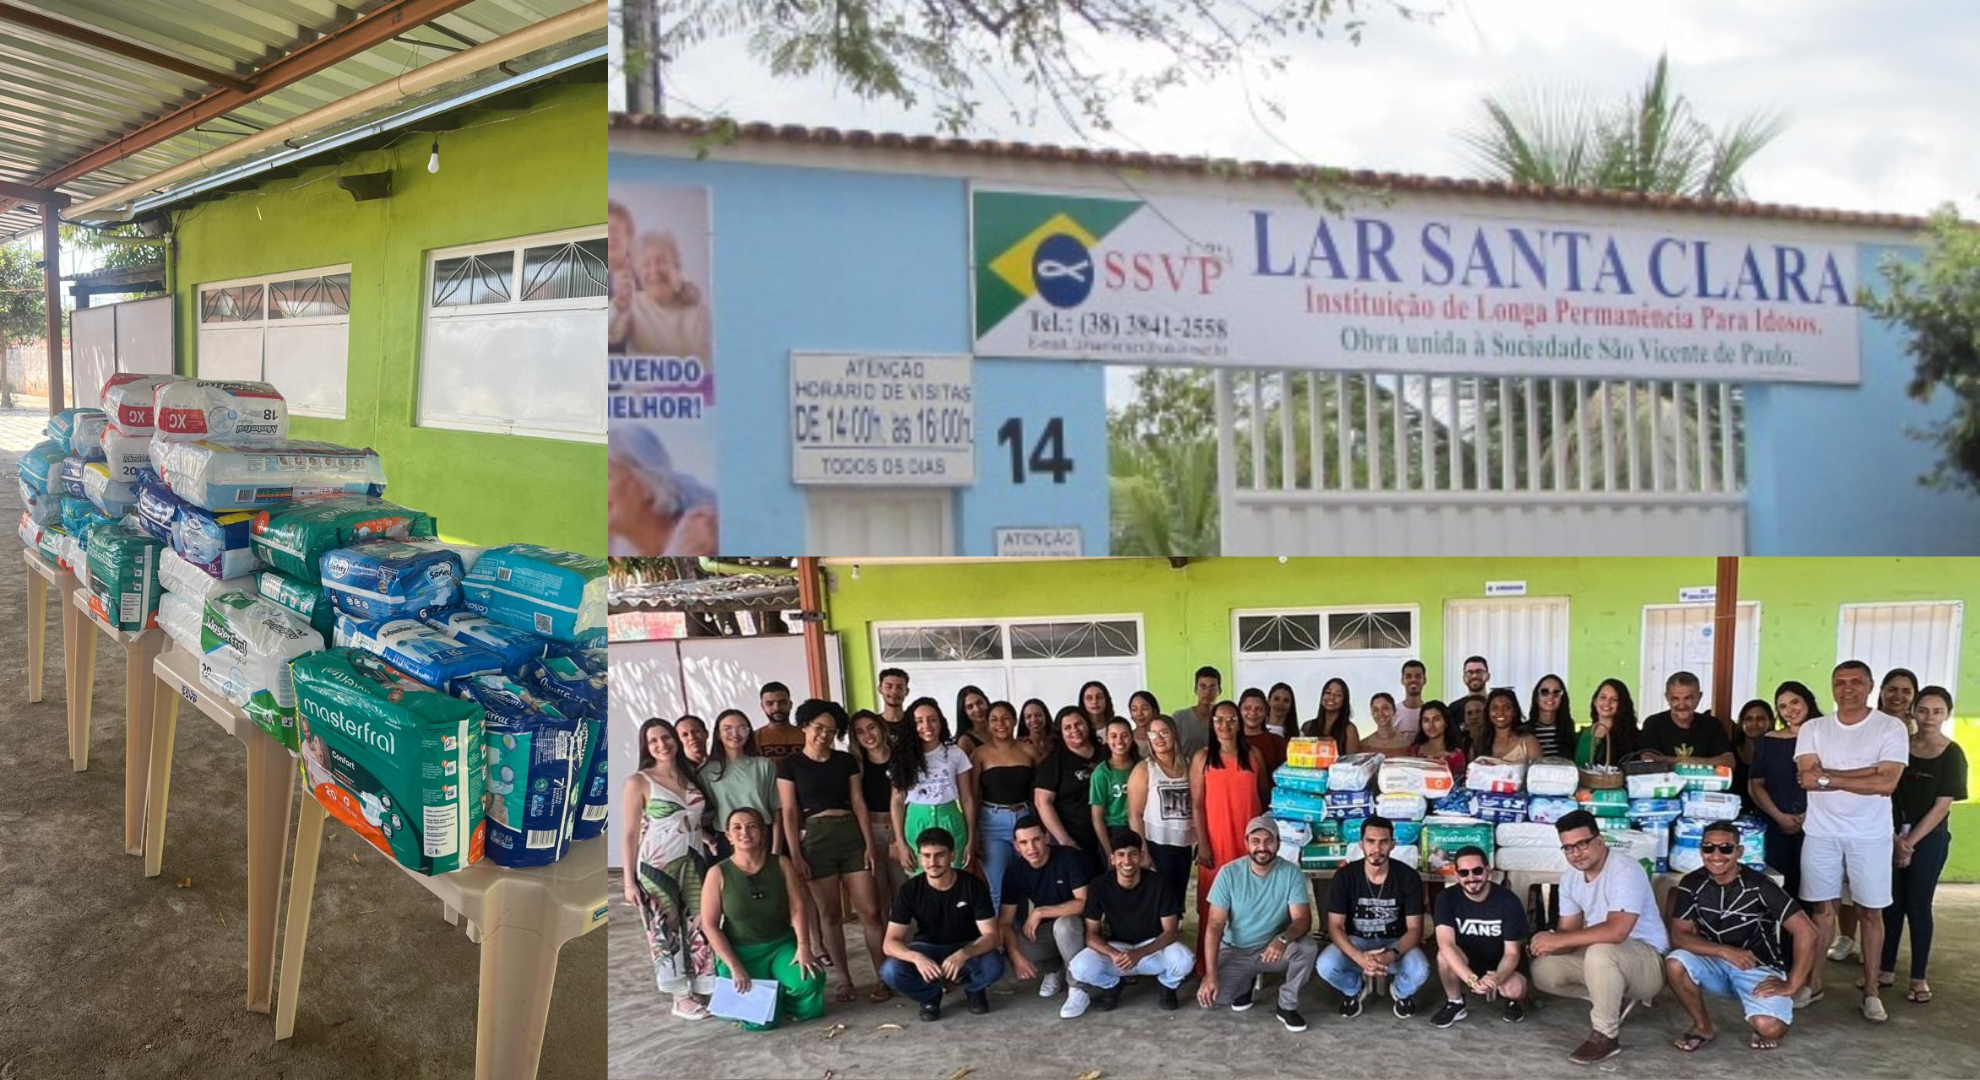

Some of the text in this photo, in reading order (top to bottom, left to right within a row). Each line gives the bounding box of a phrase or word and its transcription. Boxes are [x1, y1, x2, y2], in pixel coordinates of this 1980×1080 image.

[1249, 209, 1857, 306] LAR SANTA CLARA
[1104, 250, 1223, 295] SSVP
[1305, 285, 1823, 335] Instituição de Longa Permanência Para Idosos.
[1028, 309, 1229, 339] Tel.: (38) 3841-2558
[1340, 326, 1399, 353] Obra
[1406, 330, 1467, 357] unida
[1492, 332, 1593, 361] Sociedade
[1599, 336, 1634, 361] São
[1638, 338, 1708, 364] Vicente
[1713, 342, 1737, 365] de
[1740, 343, 1799, 367] Paulo.
[795, 379, 971, 403] HORÁRIO DE VISITAS
[129, 410, 146, 424] XG
[168, 413, 187, 429] XG
[263, 409, 279, 421] 18
[795, 405, 821, 442] DE
[997, 417, 1073, 484] 14
[821, 458, 945, 475] TODOS OS DIAS
[419, 608, 427, 619] G
[203, 614, 248, 657] Masterfral
[304, 698, 396, 756] masterfral
[331, 749, 356, 771] Confort
[324, 785, 337, 801] 20
[343, 795, 350, 807] G
[1455, 917, 1502, 937] VANS
